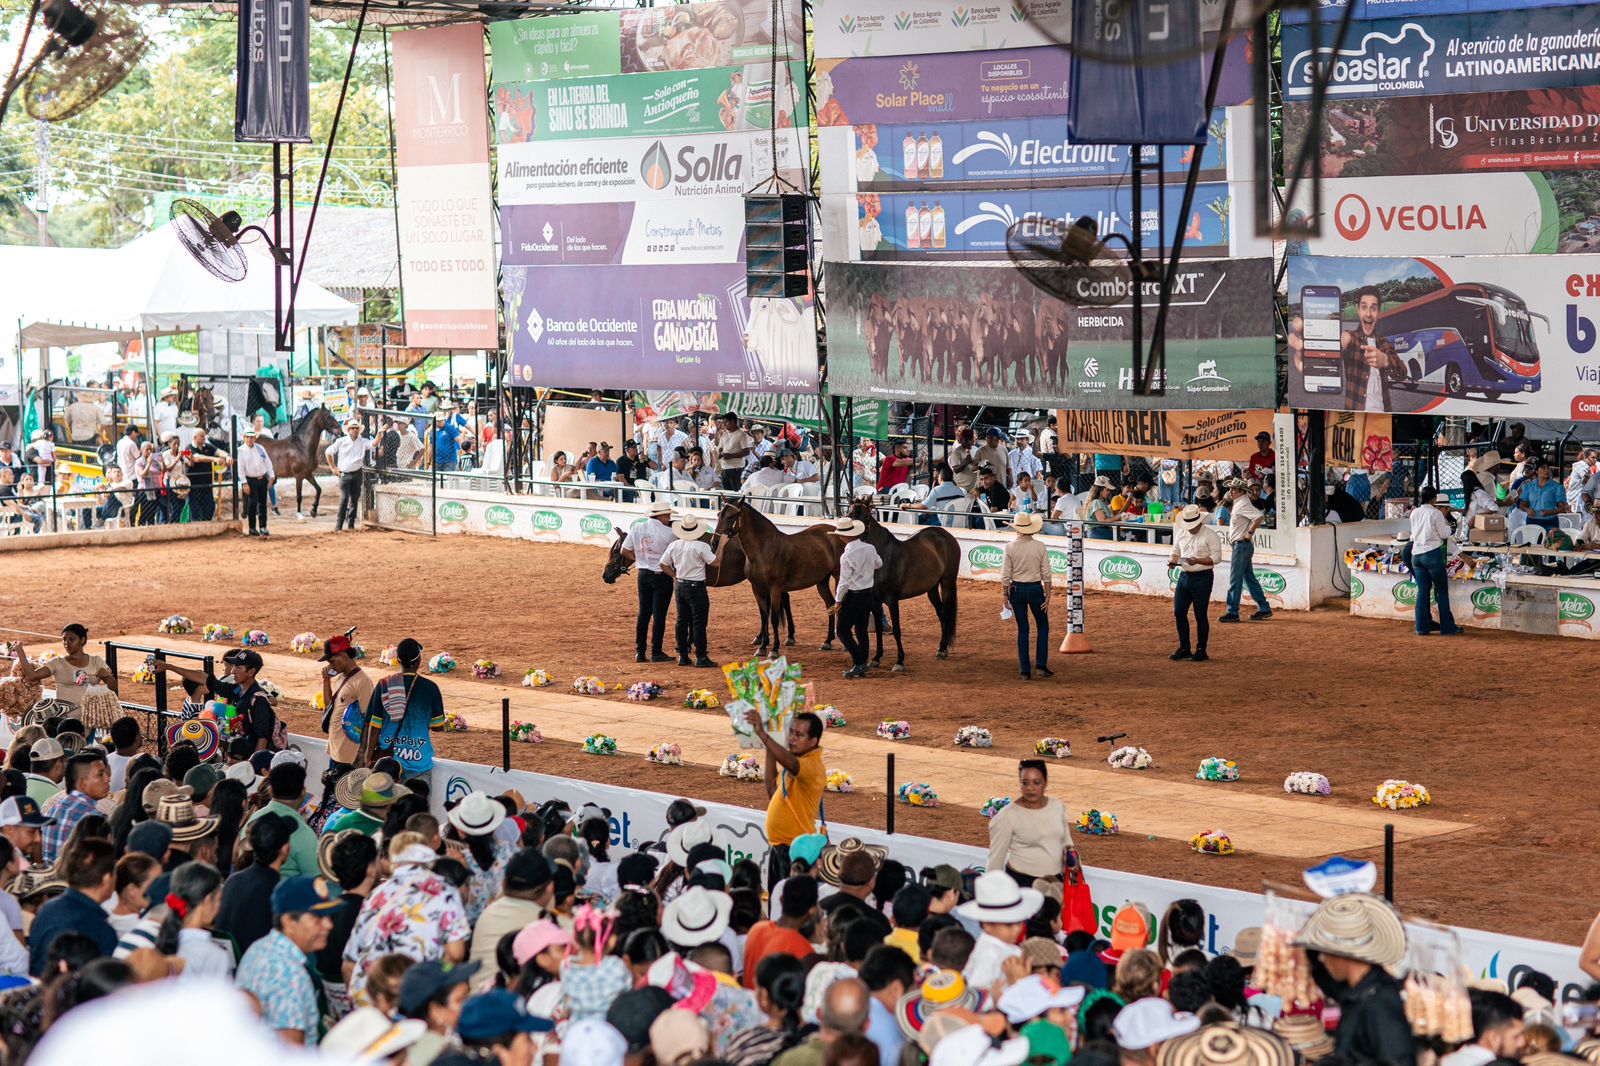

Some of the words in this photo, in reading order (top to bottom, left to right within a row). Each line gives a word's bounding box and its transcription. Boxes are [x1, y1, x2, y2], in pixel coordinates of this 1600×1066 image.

[528, 27, 545, 41] ideas
[545, 27, 560, 41] para
[570, 24, 599, 38] almuerzo
[1446, 38, 1460, 57] Al
[1460, 36, 1506, 56] servicio
[1508, 34, 1523, 53] de
[1526, 33, 1538, 51] la
[987, 69, 1023, 78] DISPONIBLES
[548, 87, 558, 106] EN
[568, 85, 596, 105] TIERRA
[595, 84, 610, 103] DEL
[654, 85, 671, 101] Solo
[672, 80, 687, 95] con
[980, 84, 990, 92] Tu
[991, 82, 1019, 93] negocio
[1019, 83, 1029, 91] en
[1378, 80, 1424, 91] COLOMBIA
[643, 88, 699, 117] Antioqueño
[876, 93, 908, 109] Solar
[909, 91, 944, 107] Place
[981, 93, 1016, 114] espacio
[574, 106, 588, 130] SE
[588, 103, 628, 129] BRINDA
[1464, 114, 1583, 133] UNIVERSIDAD
[1530, 134, 1587, 145] Bechara
[505, 159, 578, 178] Alimentación
[579, 157, 629, 175] eficiente
[674, 142, 743, 183] Solla
[526, 182, 537, 190] para
[538, 181, 557, 190] ganado
[602, 178, 608, 186] de
[608, 177, 636, 188] exposición
[674, 185, 711, 196] Nutrición
[714, 182, 744, 194] Animal
[411, 199, 439, 212] TODO
[441, 198, 454, 211] LO
[456, 197, 479, 210] QUE
[414, 211, 460, 228] SOÑASTE
[462, 213, 476, 226] EN
[695, 217, 722, 237] Metas
[1022, 211, 1119, 237] Electlit
[1376, 204, 1487, 231] VEOLIA
[406, 231, 420, 243] UN
[421, 230, 449, 243] SOLO
[409, 260, 438, 272] TODO
[440, 260, 453, 272] ES
[455, 259, 487, 272] TODO.
[677, 299, 718, 321] NACIONAL
[546, 318, 575, 332] Banco
[576, 318, 588, 332] de
[589, 318, 638, 333] Occidente
[1077, 316, 1124, 327] HERBICIDA
[547, 337, 555, 345] 60
[555, 338, 568, 346] años
[568, 338, 577, 346] del
[577, 338, 589, 346] lado
[589, 338, 597, 346] de
[597, 338, 605, 346] los
[605, 339, 615, 348] que
[653, 321, 719, 352] GANADERÍA
[1186, 385, 1202, 393] Súper
[725, 392, 740, 415] LA
[740, 392, 778, 416] FIESTA
[778, 393, 795, 417] SE
[1066, 409, 1078, 442] LA
[1079, 409, 1112, 443] FIESTA
[1112, 410, 1124, 444] ES
[1125, 410, 1171, 447] REAL
[1195, 417, 1216, 430] Solo
[1216, 411, 1233, 424] con
[1180, 419, 1247, 445] Antioqueño
[1332, 425, 1356, 464] REAL
[1103, 559, 1136, 575] Codelac
[1256, 573, 1280, 588] delac
